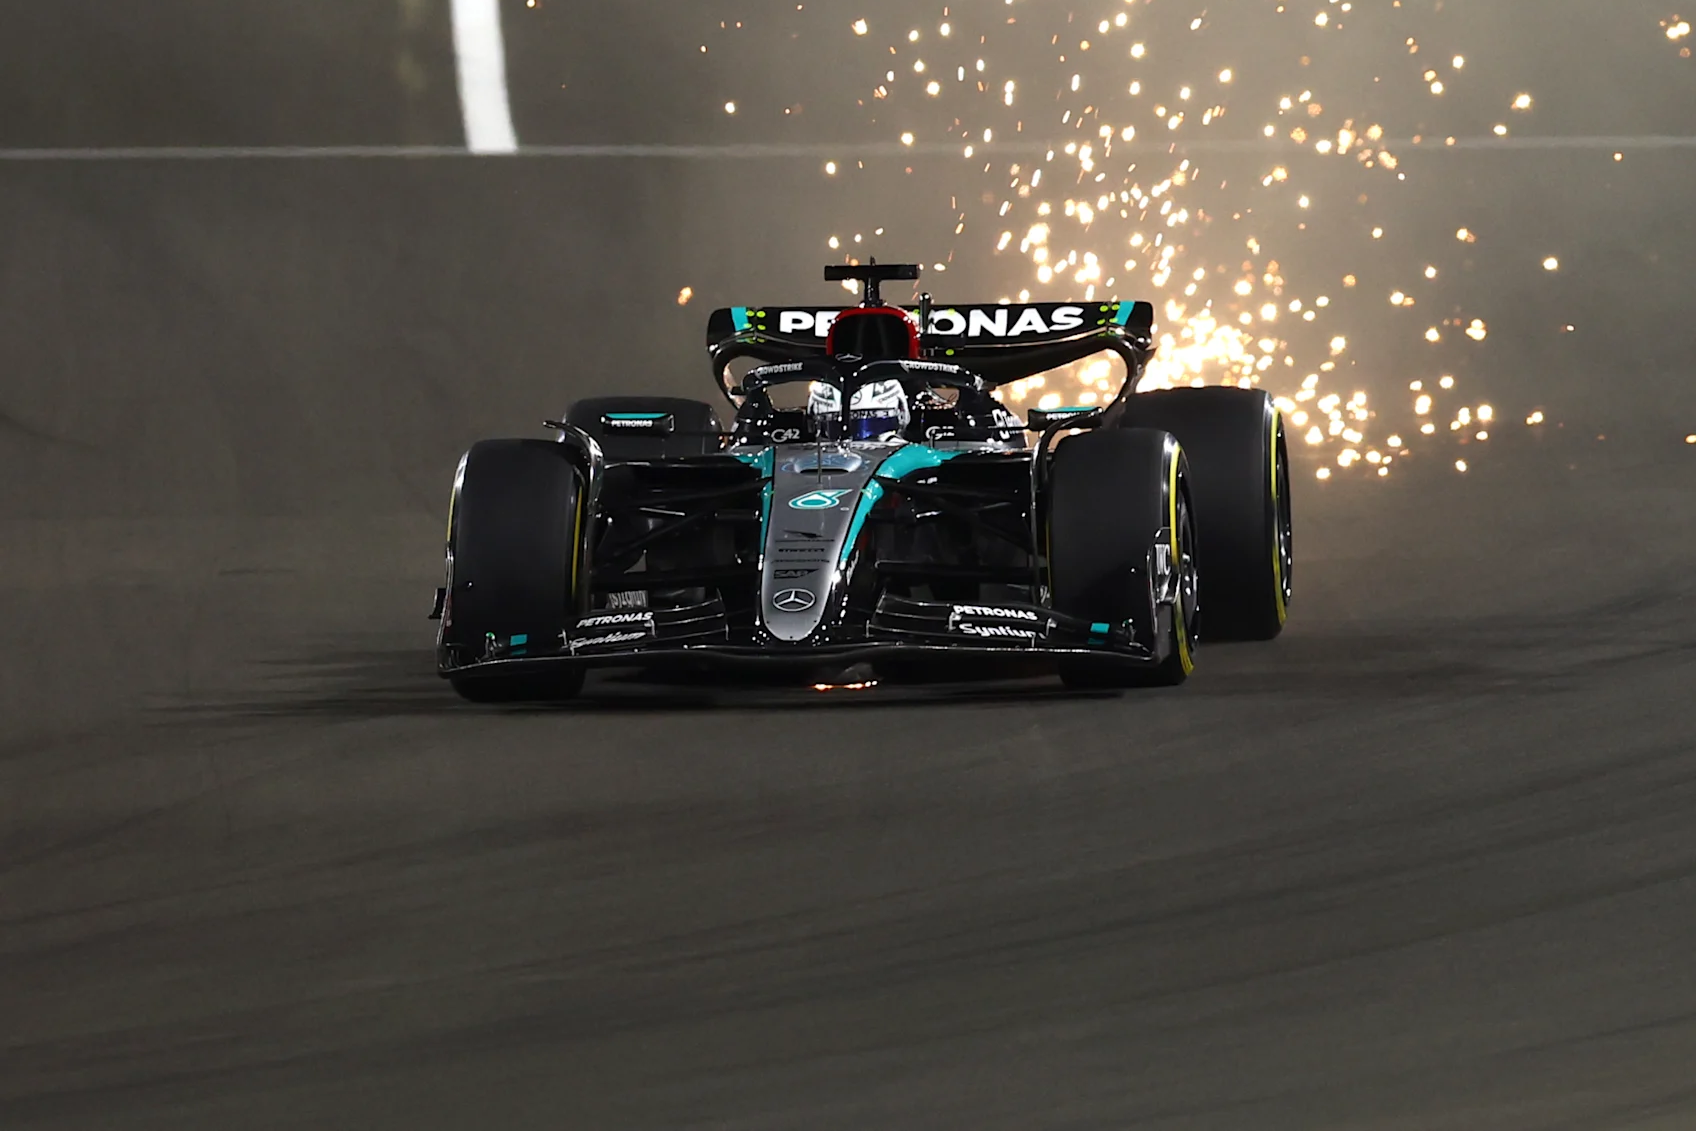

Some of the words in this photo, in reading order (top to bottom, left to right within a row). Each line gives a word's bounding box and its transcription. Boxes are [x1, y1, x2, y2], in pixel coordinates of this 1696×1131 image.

[778, 305, 1085, 338] PEONAS
[755, 362, 803, 379] CROWDSTRIKE
[611, 419, 653, 428] PETRONAS
[771, 428, 801, 443] G42
[576, 611, 654, 629] PETRONAS
[953, 605, 1038, 621] PETRONAS
